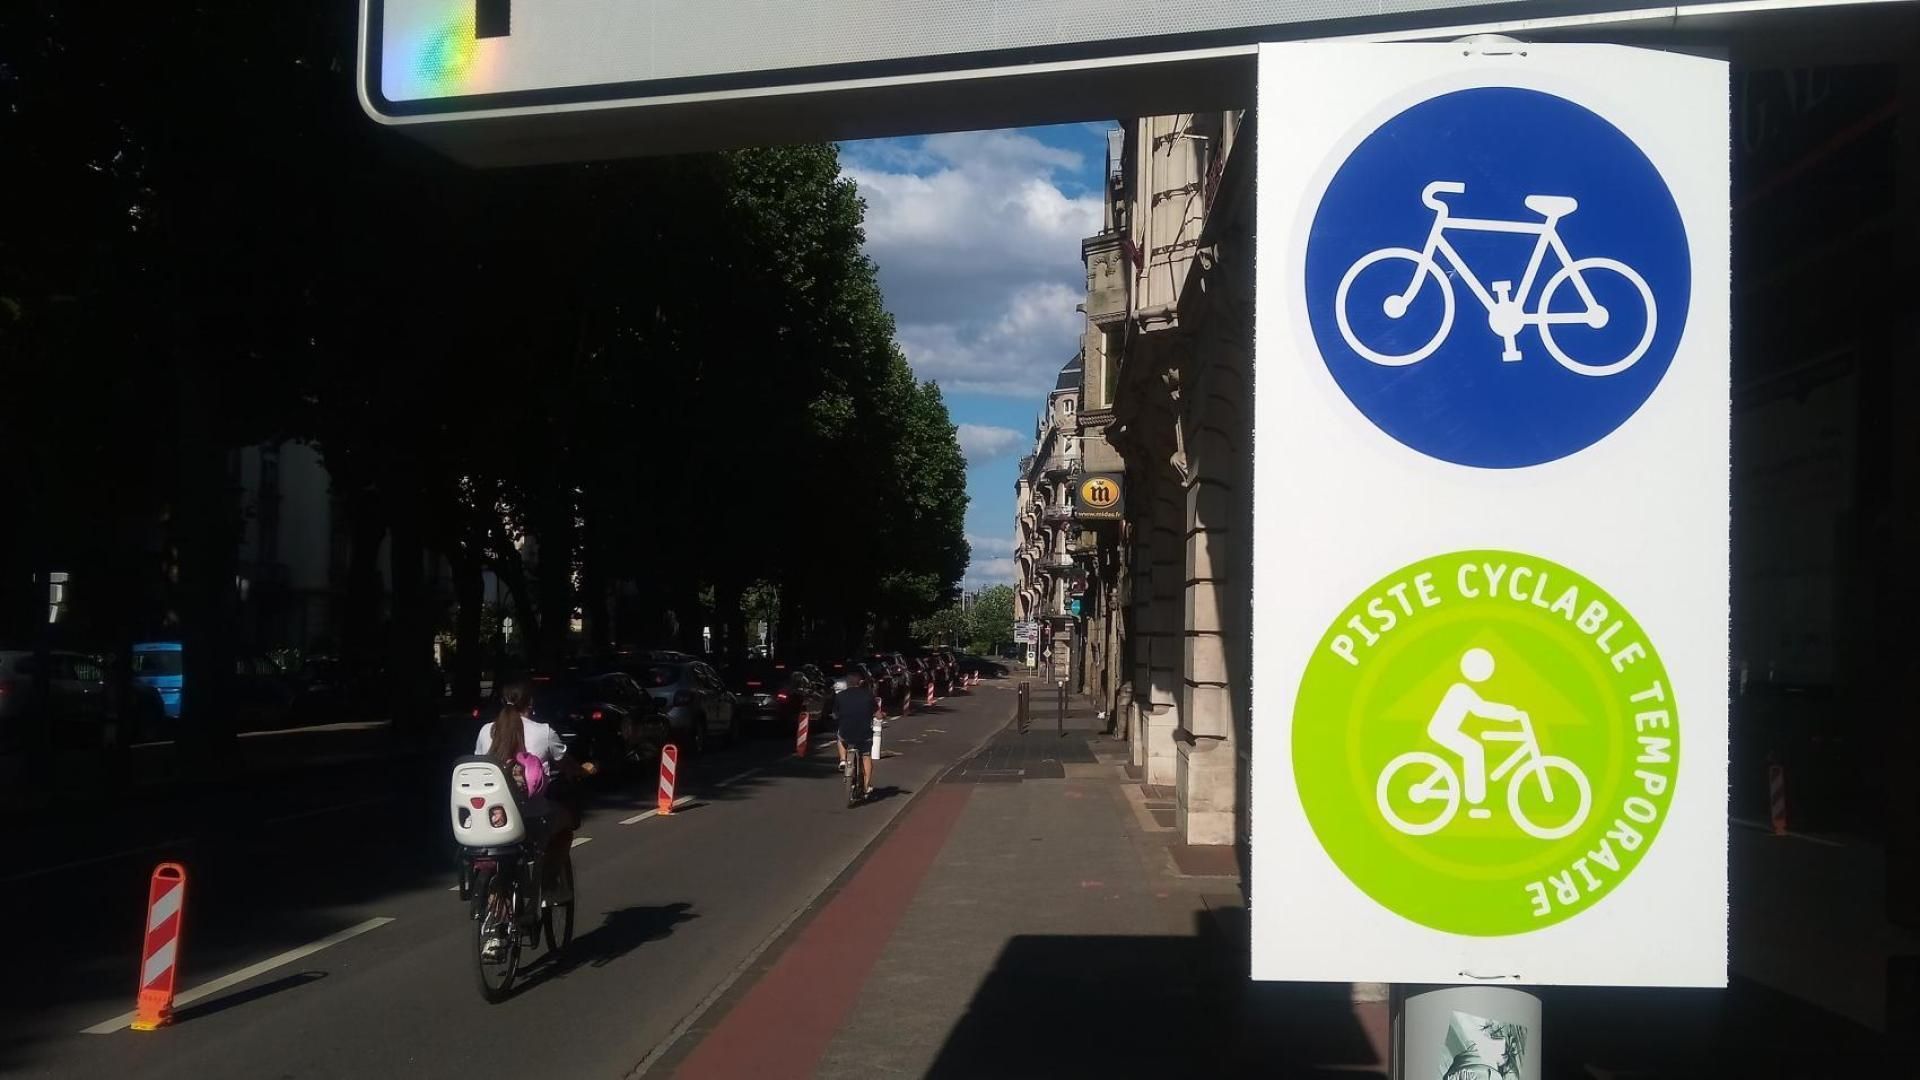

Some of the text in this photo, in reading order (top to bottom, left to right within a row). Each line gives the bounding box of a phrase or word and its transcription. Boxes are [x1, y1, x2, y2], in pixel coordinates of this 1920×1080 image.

[1330, 563, 1671, 918] PISTE CYCLABLE TEMPORAIRE
